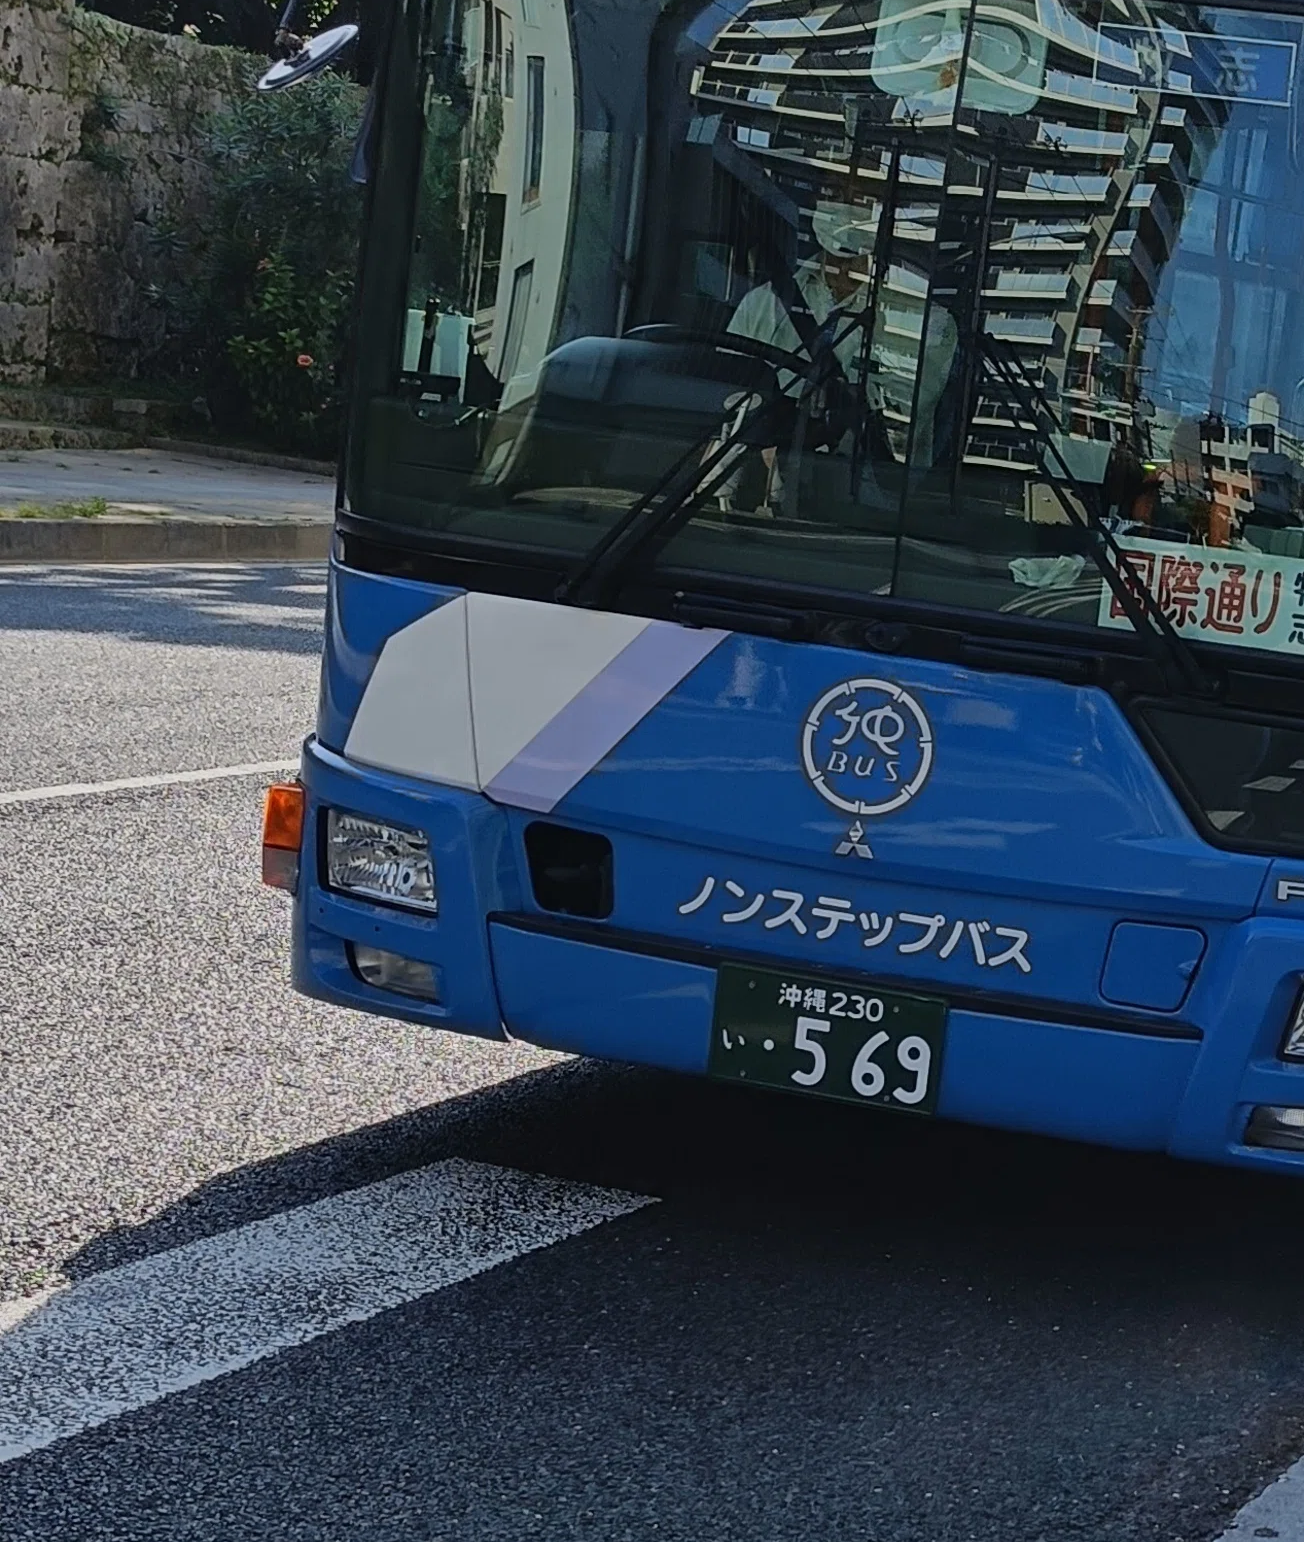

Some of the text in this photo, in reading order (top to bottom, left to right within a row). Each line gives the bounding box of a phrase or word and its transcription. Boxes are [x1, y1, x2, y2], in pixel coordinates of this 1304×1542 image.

[827, 750, 902, 782] BUS
[678, 876, 1033, 973] ノンステップバス
